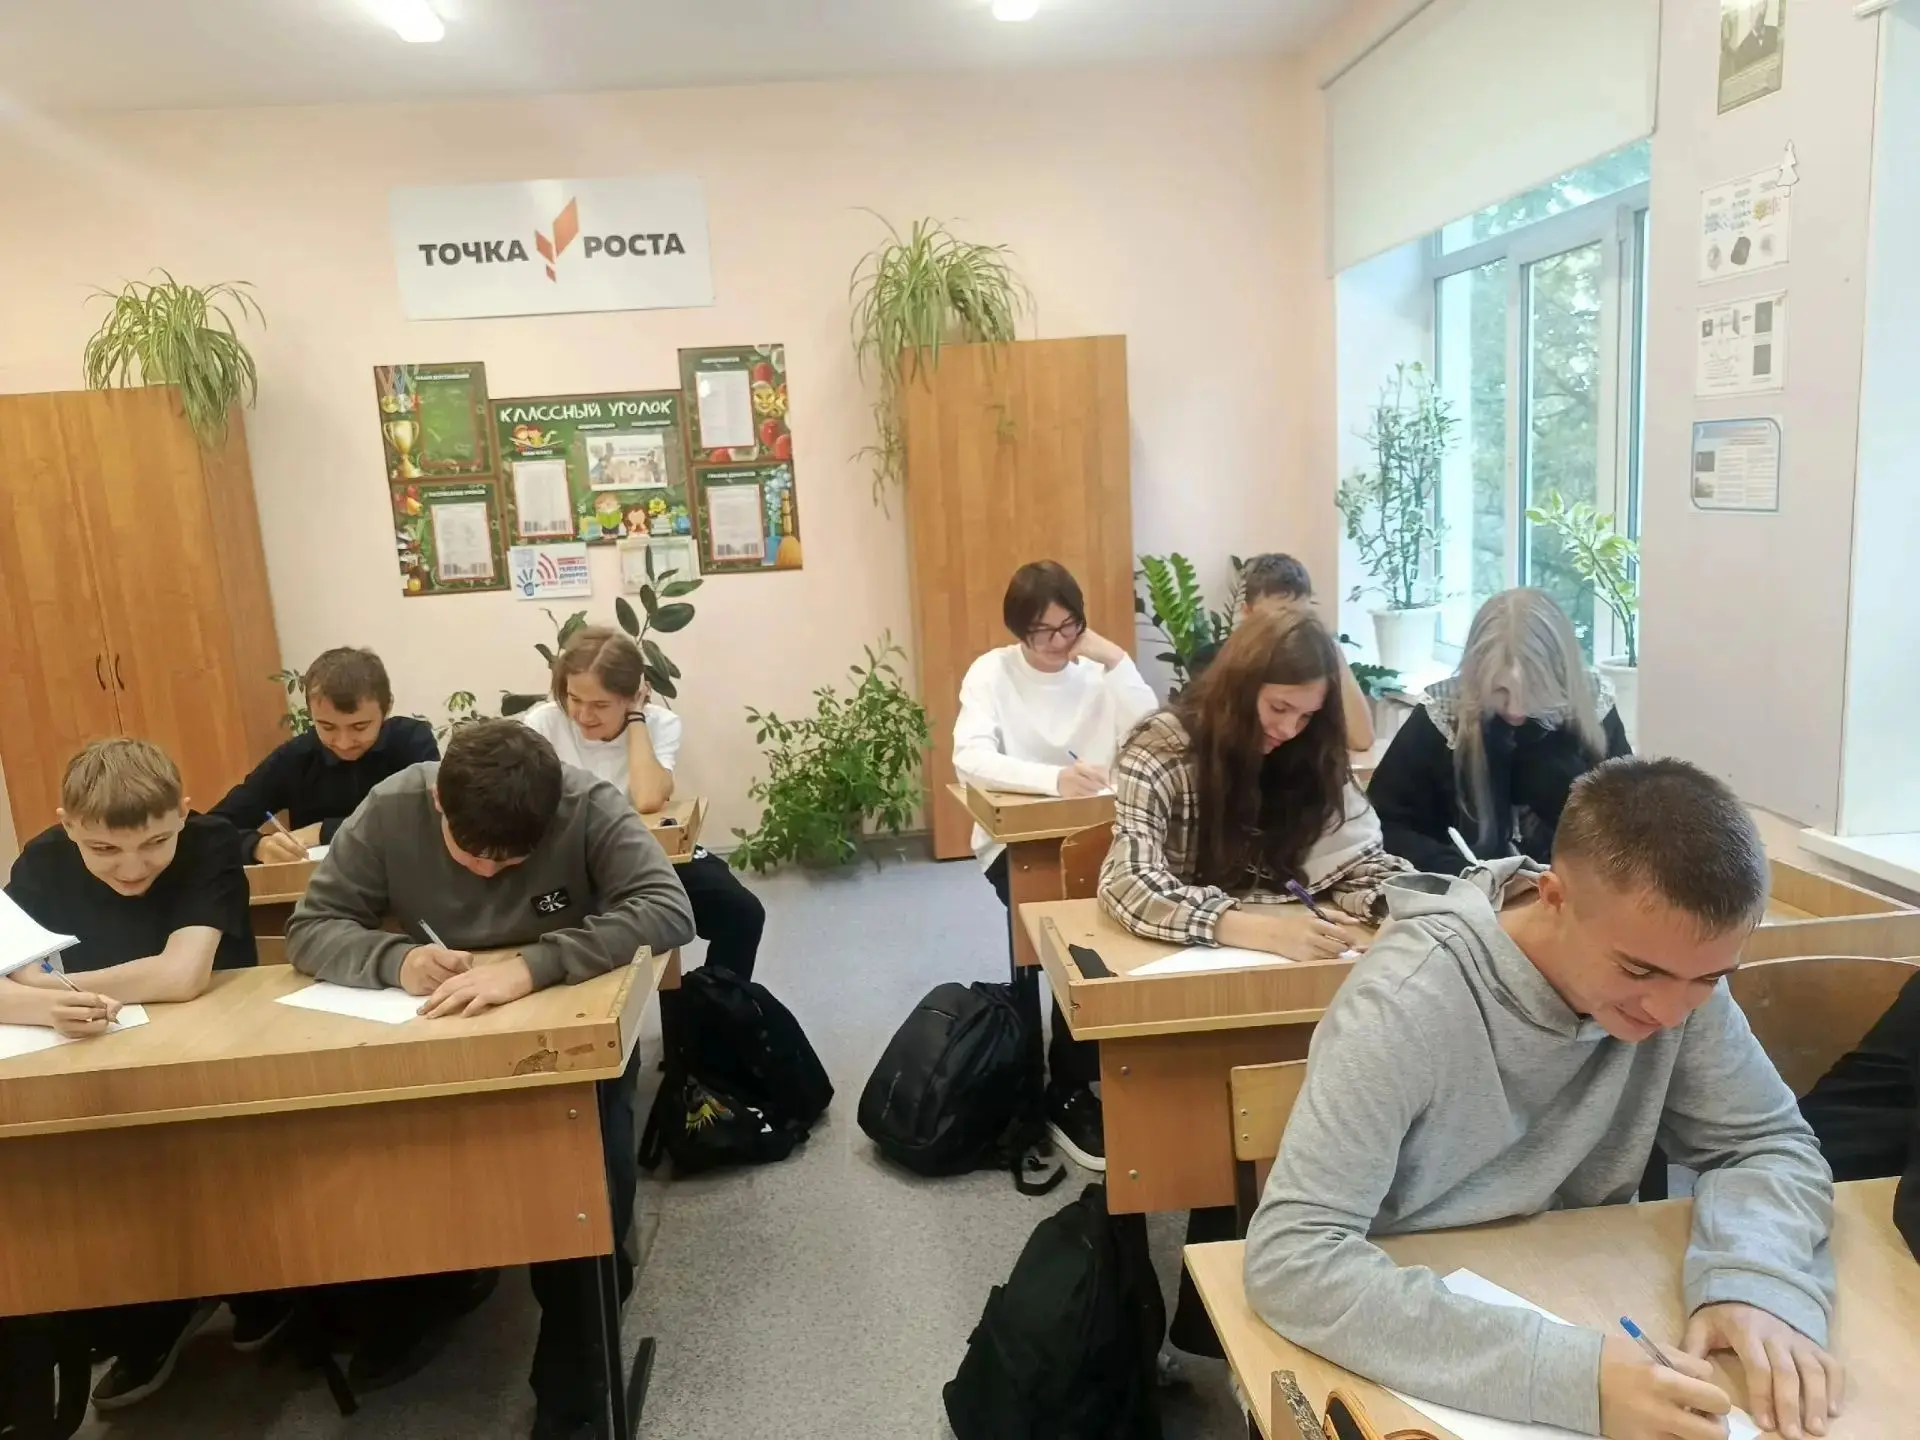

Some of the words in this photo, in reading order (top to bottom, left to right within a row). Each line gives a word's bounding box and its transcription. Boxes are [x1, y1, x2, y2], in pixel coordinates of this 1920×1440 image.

[418, 240, 529, 266] ТОЧКА
[583, 233, 686, 258] РОСТА
[500, 402, 601, 422] КЛАССНЫЙ
[608, 399, 673, 417] УГОЛОК
